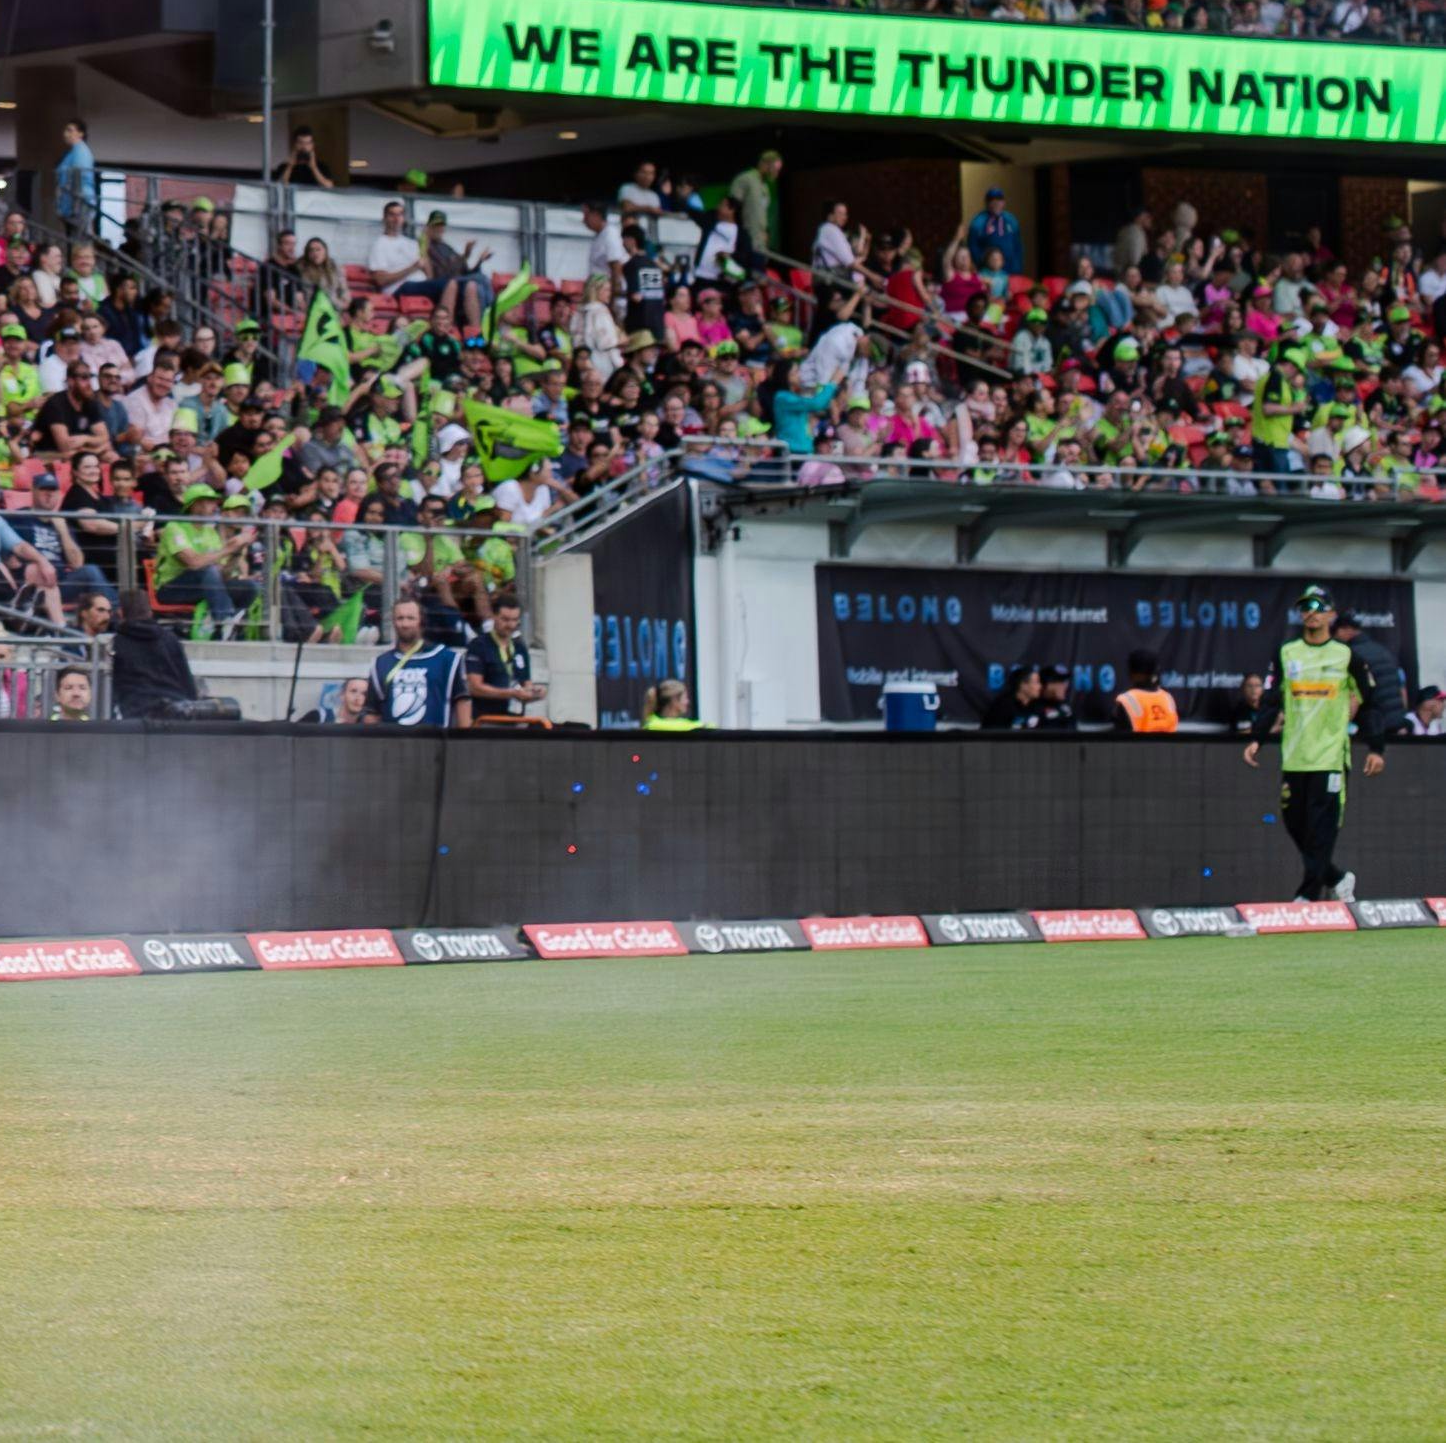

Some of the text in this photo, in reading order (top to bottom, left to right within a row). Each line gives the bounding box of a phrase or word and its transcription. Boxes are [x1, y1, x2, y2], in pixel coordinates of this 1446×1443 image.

[504, 22, 1392, 114] WE ARE THE THUNDER NATION
[537, 926, 677, 952] Good for Cricket
[721, 924, 794, 948] TOYOTA
[963, 917, 1028, 939] TOYOTA
[170, 942, 242, 966] TOYOTA
[258, 935, 393, 963] Good for Cricket
[438, 934, 510, 958] TOYOTA
[37, 947, 65, 973] for
[65, 945, 133, 971] Cricket
